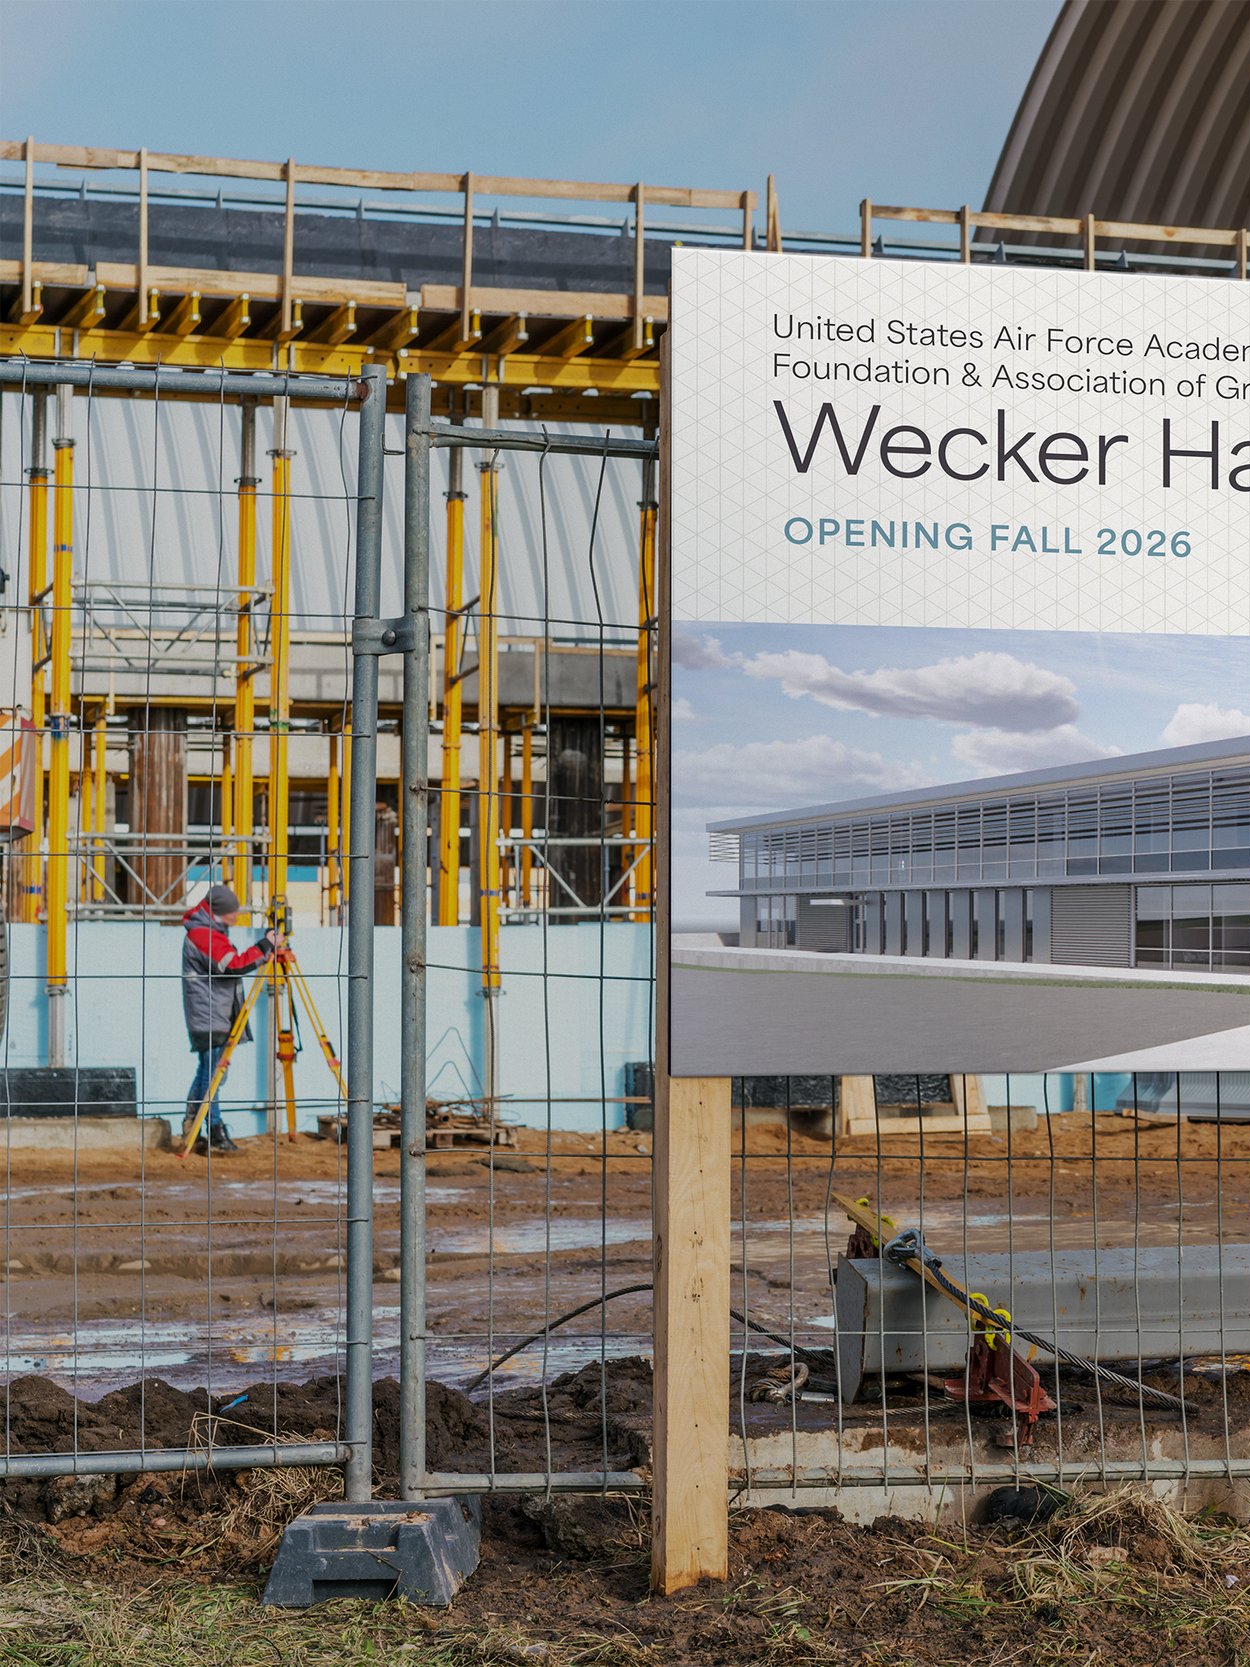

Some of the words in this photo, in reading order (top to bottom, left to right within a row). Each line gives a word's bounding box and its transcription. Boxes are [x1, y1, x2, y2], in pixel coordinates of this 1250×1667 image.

[774, 313, 875, 343] United
[886, 319, 984, 349] States
[993, 325, 1037, 351] Air
[1047, 328, 1134, 357] Force
[773, 352, 950, 386] Foundation
[961, 362, 983, 388] &
[991, 364, 1165, 396] Association
[1176, 373, 1207, 398] of
[772, 399, 1129, 487] Wecker
[783, 516, 973, 551] OPENING
[990, 524, 1083, 554] FALL
[1096, 528, 1192, 558] 2026
